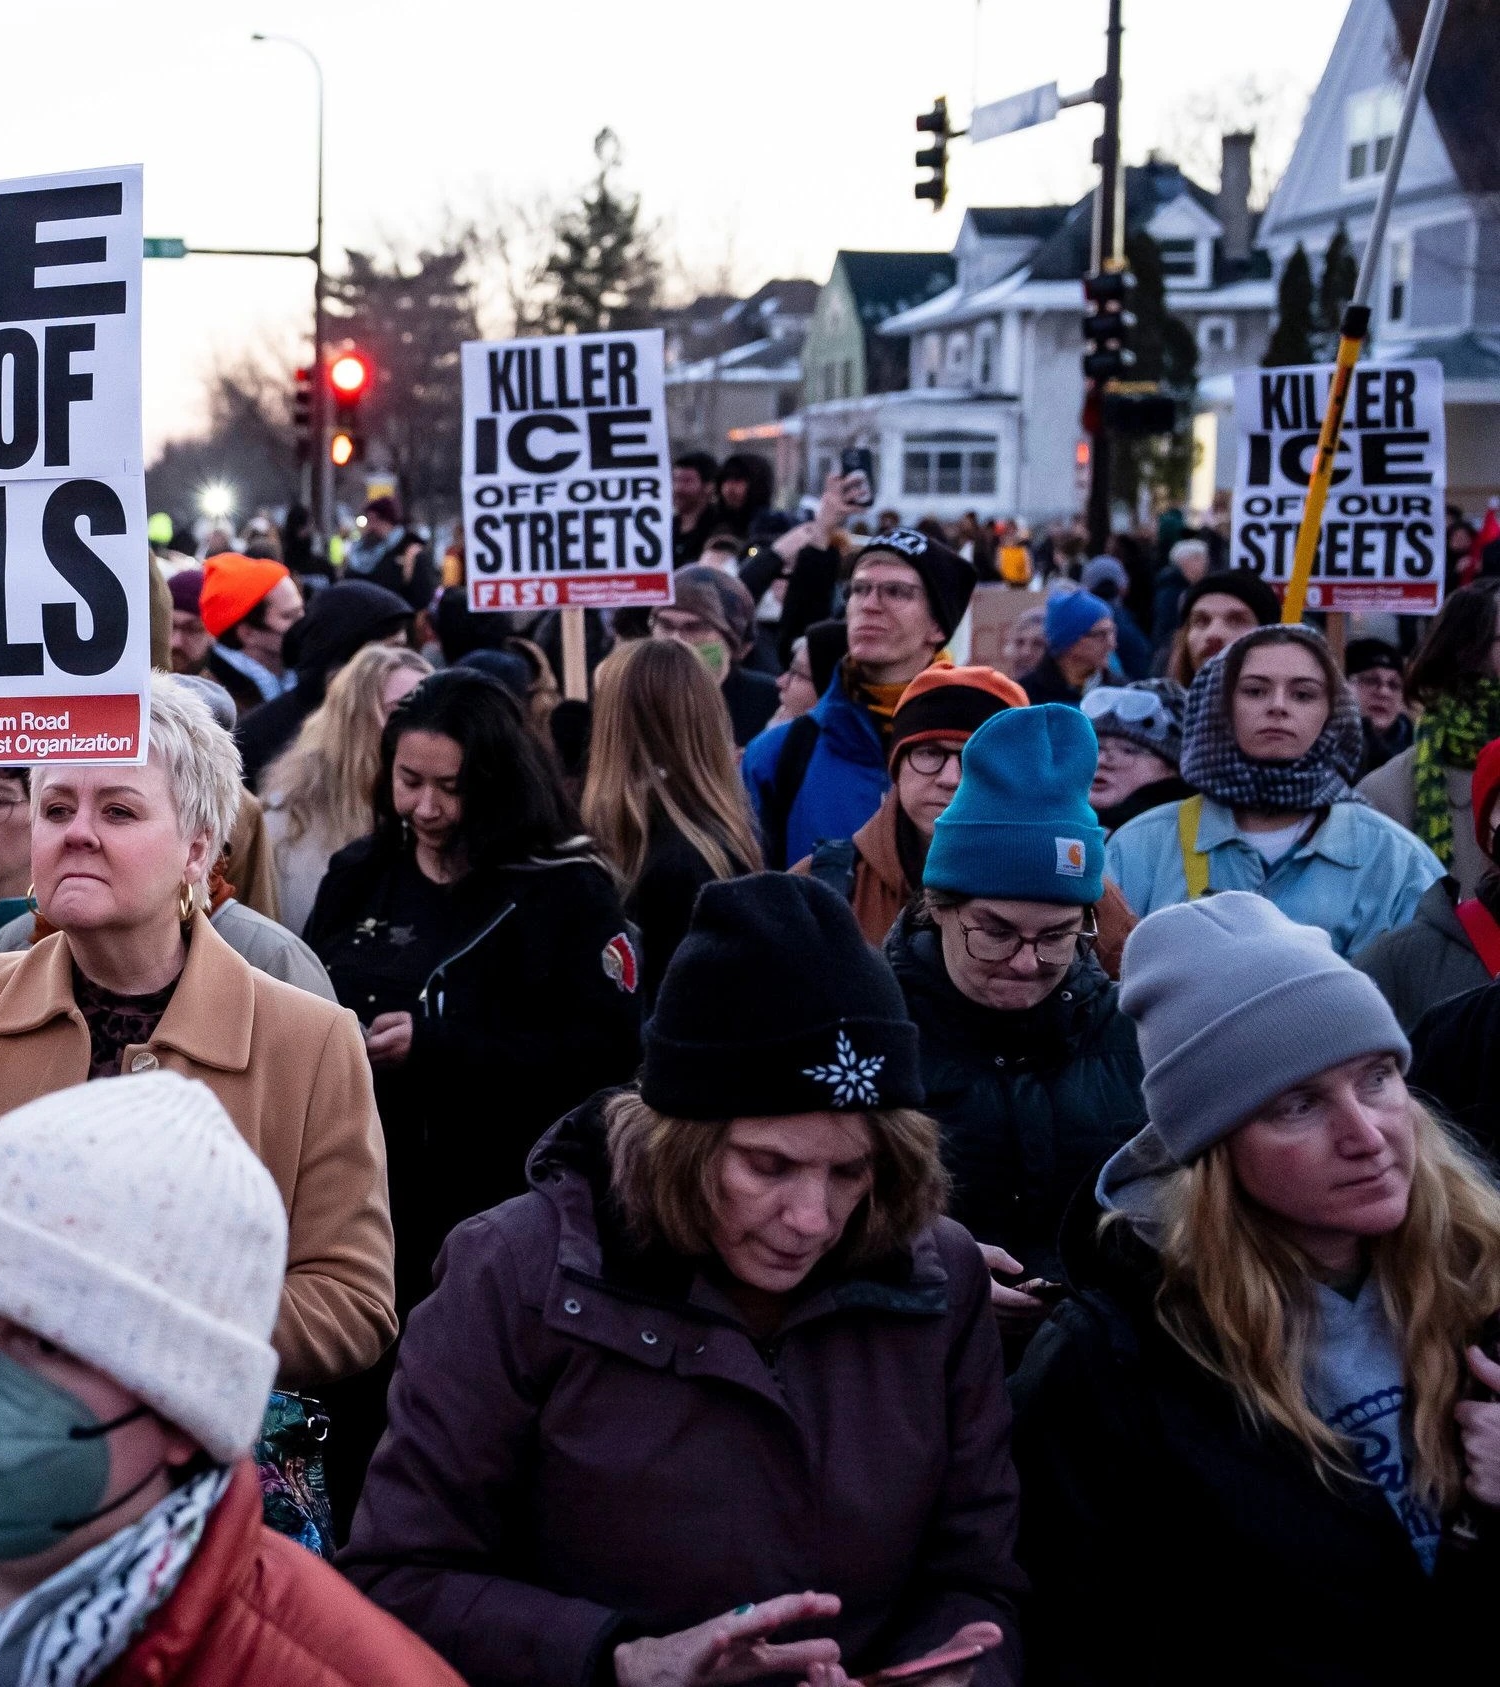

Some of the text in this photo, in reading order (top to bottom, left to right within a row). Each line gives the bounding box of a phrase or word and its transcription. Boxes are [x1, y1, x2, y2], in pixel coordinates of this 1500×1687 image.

[488, 342, 638, 413] KILLER
[475, 409, 659, 475] ICE
[1248, 432, 1433, 487] ICE
[474, 478, 660, 508] OFF OUR
[1244, 495, 1432, 516] OF OUR
[473, 506, 663, 574] STREETS
[21, 711, 70, 731] Road
[15, 733, 131, 757] Organization
